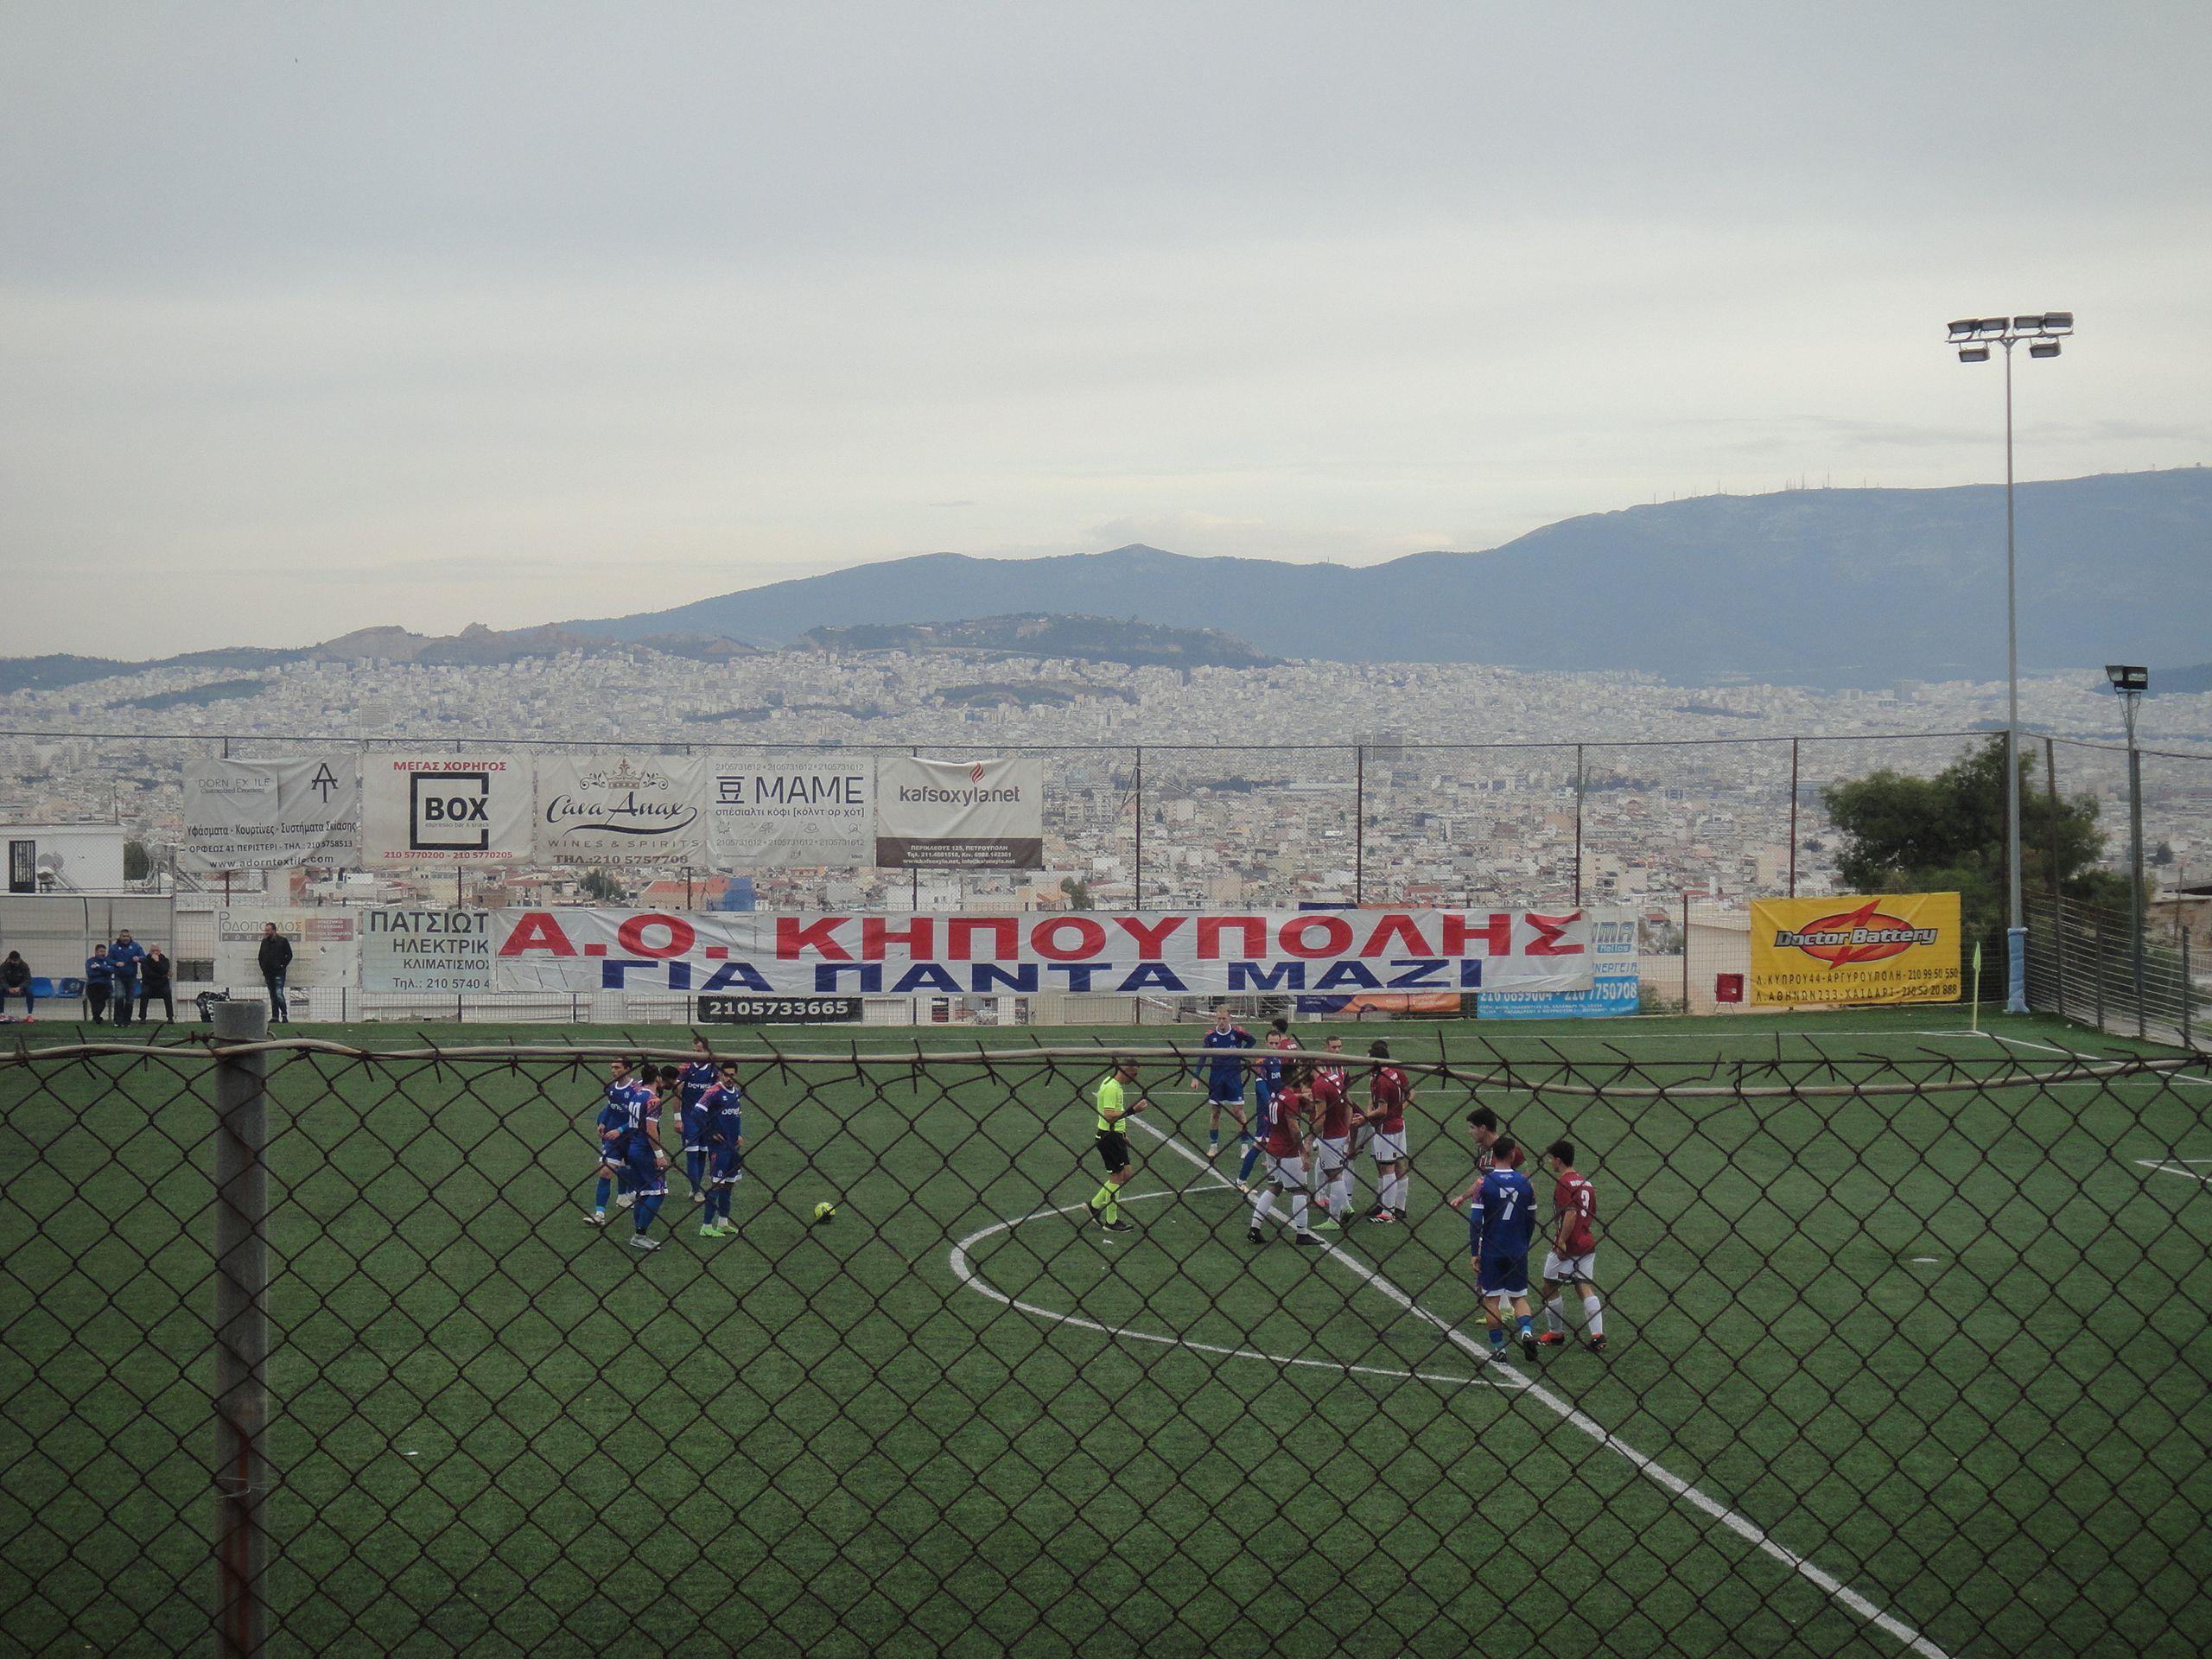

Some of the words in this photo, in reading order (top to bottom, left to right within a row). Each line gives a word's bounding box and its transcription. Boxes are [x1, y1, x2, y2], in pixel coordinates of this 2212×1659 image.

[393, 761, 440, 771] ΜΕΓΑΣ
[443, 761, 507, 771] ΧΟΡΗΓΟΣ
[755, 776, 865, 804] MAME
[899, 785, 1020, 807] kafsoxyla.net
[424, 797, 489, 821] BOX
[546, 794, 602, 823] Cava
[767, 806, 790, 818] κόφι
[187, 823, 229, 838] Υφάσματα
[235, 823, 275, 837] Κουρτίνες
[281, 822, 324, 836] Συστήματα
[189, 844, 224, 853] ΟΡΦΕΩΣ
[237, 842, 277, 852] ΠΕΡΙΣΤΕΡΙ
[393, 938, 489, 954] ΗΛΕΚΤΡΙΚ
[498, 912, 729, 959] Α.Ο.
[776, 912, 1585, 962] ΚΗΠΟΥΠΟΛΗΣ
[1774, 930, 1852, 947] Doctor
[1851, 927, 1938, 945] Battery
[427, 978, 448, 988] 210
[452, 978, 480, 988] 5740
[602, 960, 772, 992] ΓΙΑ
[815, 962, 1189, 993] ΠΑΝΤΑ
[1228, 958, 1483, 991] ΜΑΖΙ
[709, 1001, 849, 1015] 2105733665
[628, 1102, 641, 1128] 10
[1268, 1101, 1279, 1125] 10
[1499, 1187, 1519, 1220] 7
